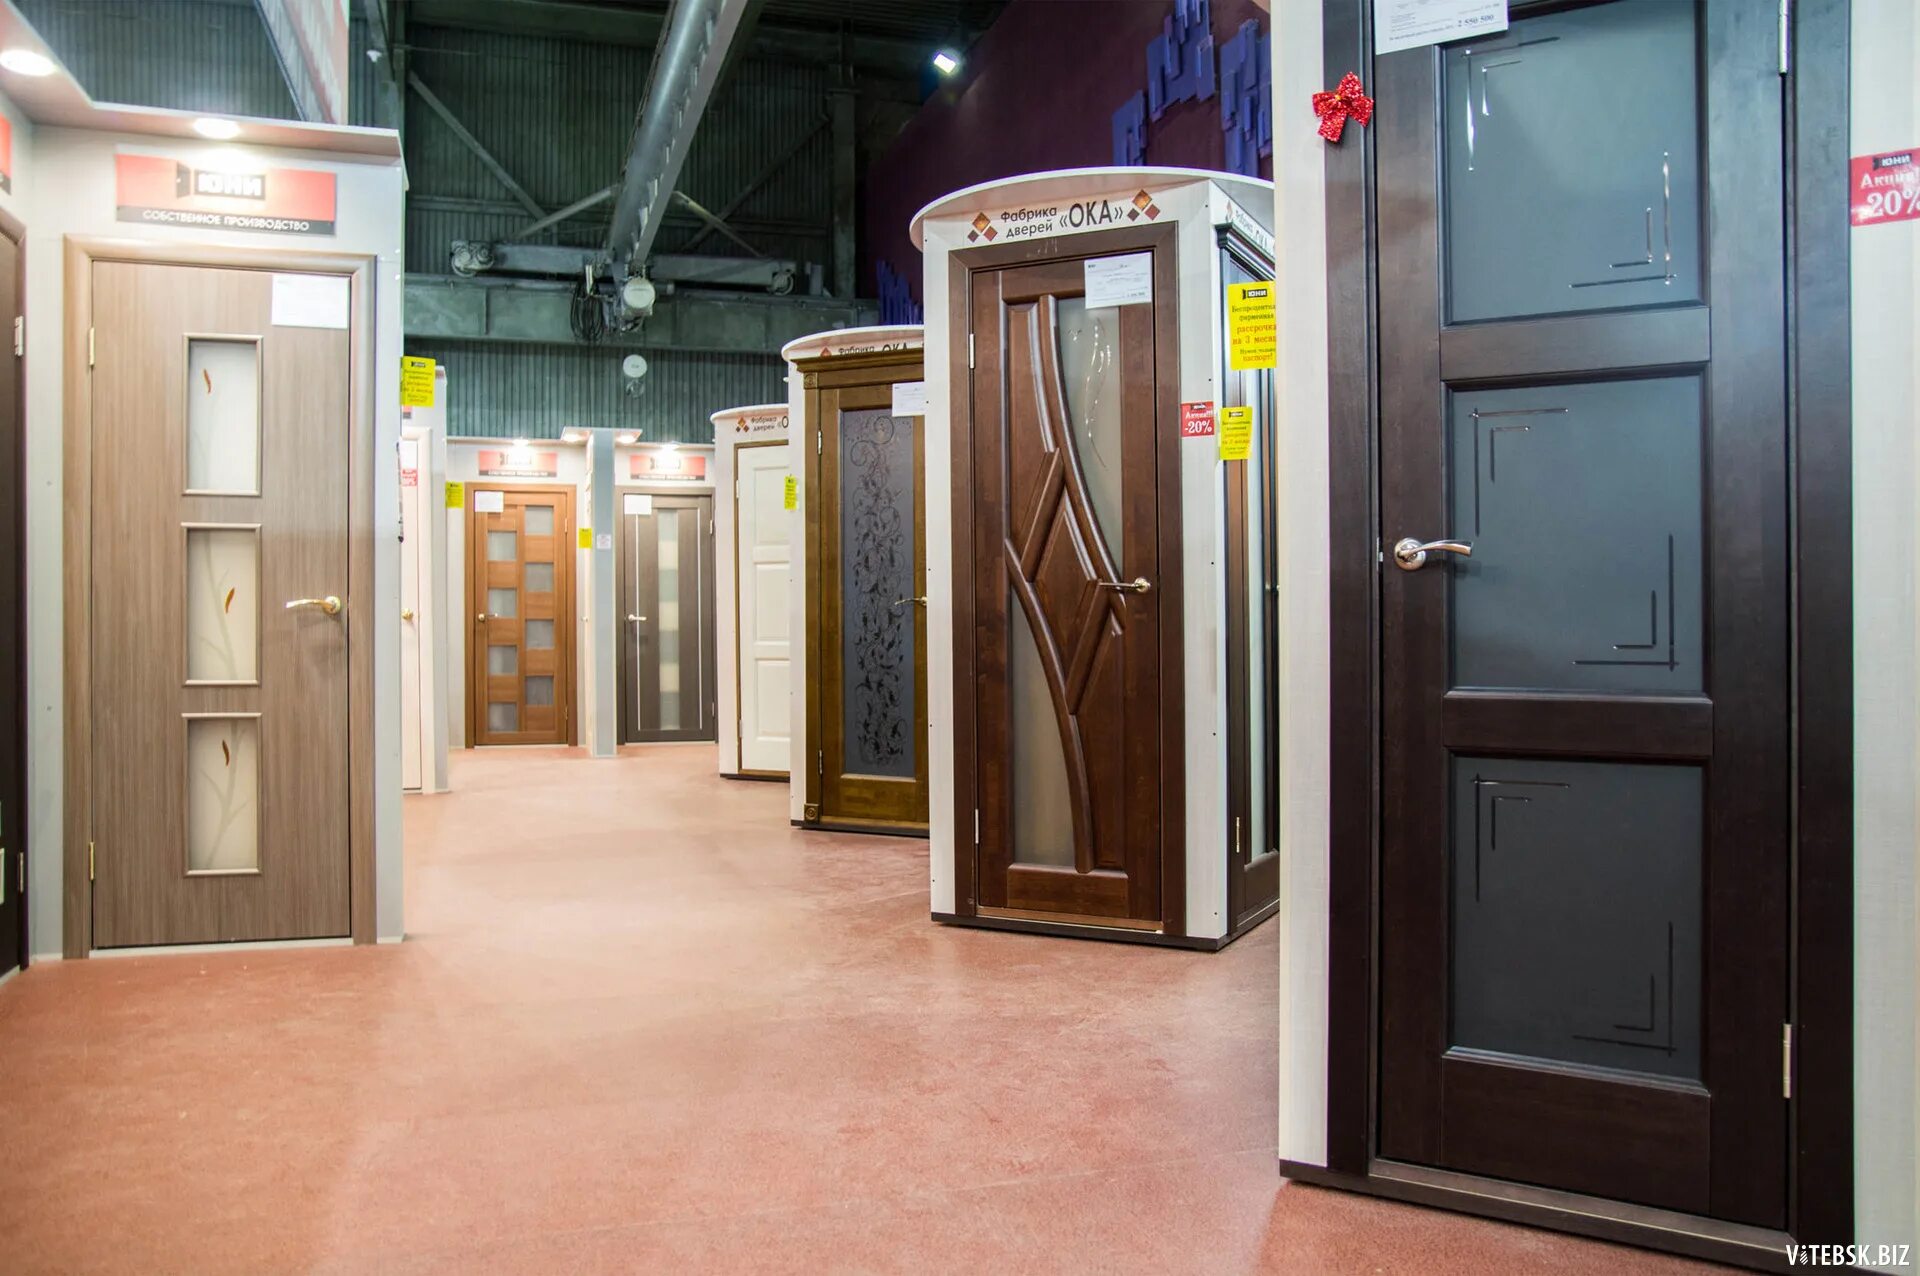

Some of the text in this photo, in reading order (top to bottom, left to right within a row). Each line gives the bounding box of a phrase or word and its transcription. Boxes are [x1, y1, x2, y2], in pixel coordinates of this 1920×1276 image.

[1882, 155, 1910, 167] ЮНИ
[198, 173, 262, 196] ЮНИ
[143, 209, 310, 231] СОБСТВЕННОЕ ПРОИЗВОДСТВО
[1001, 207, 1057, 222] Фабрика
[1006, 199, 1123, 238] дверей «ОКА»
[1248, 289, 1267, 298] ЮНИ
[1232, 304, 1276, 313] Беспроцентна
[1185, 419, 1212, 434] -20%
